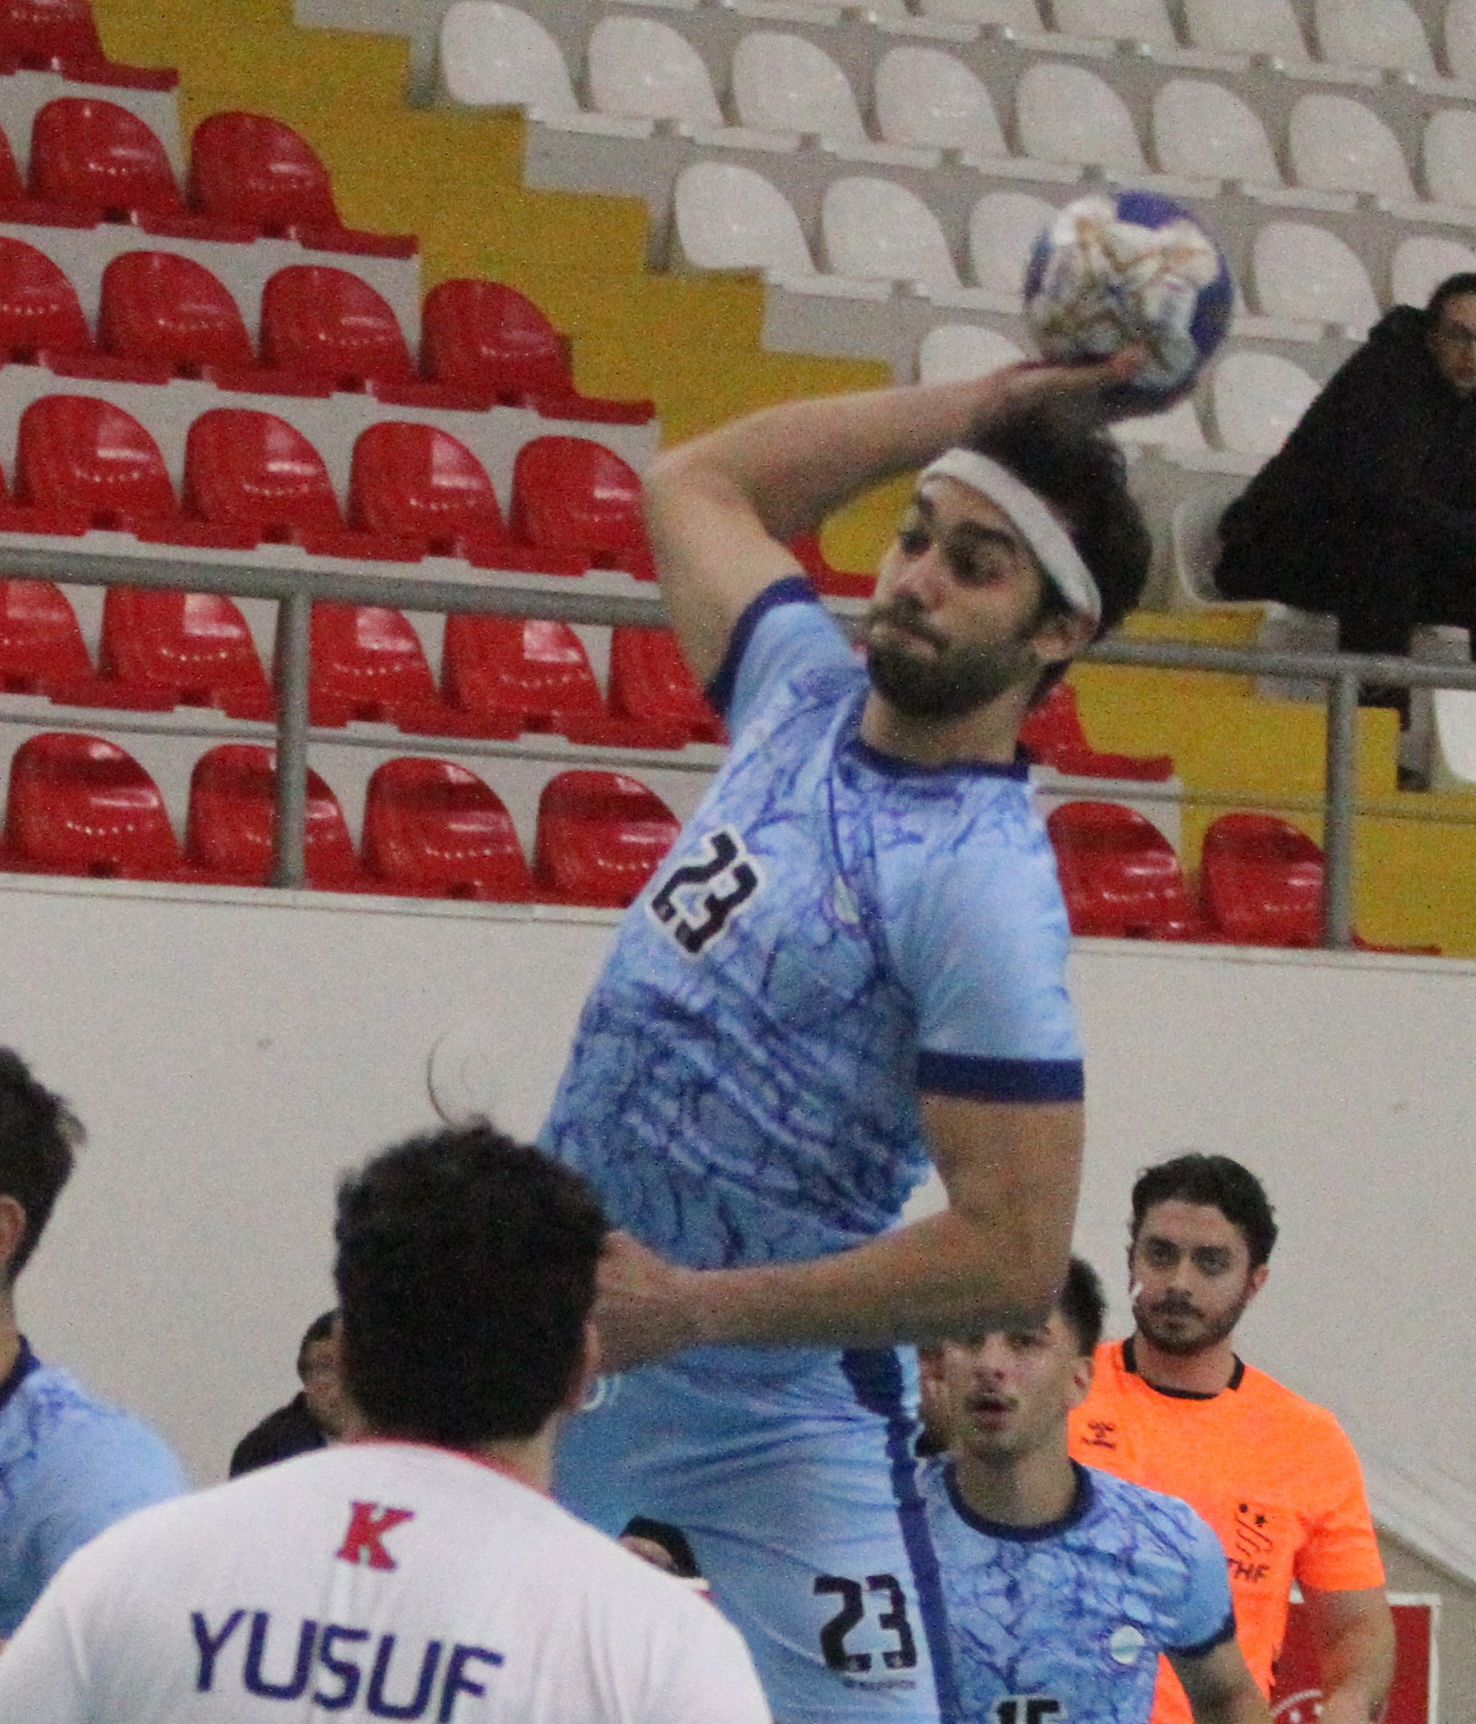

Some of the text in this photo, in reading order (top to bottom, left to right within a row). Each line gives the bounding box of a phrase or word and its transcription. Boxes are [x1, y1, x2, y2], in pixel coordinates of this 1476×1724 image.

[650, 830, 760, 955] 23
[335, 1499, 415, 1572] K
[812, 1572, 919, 1674] 23
